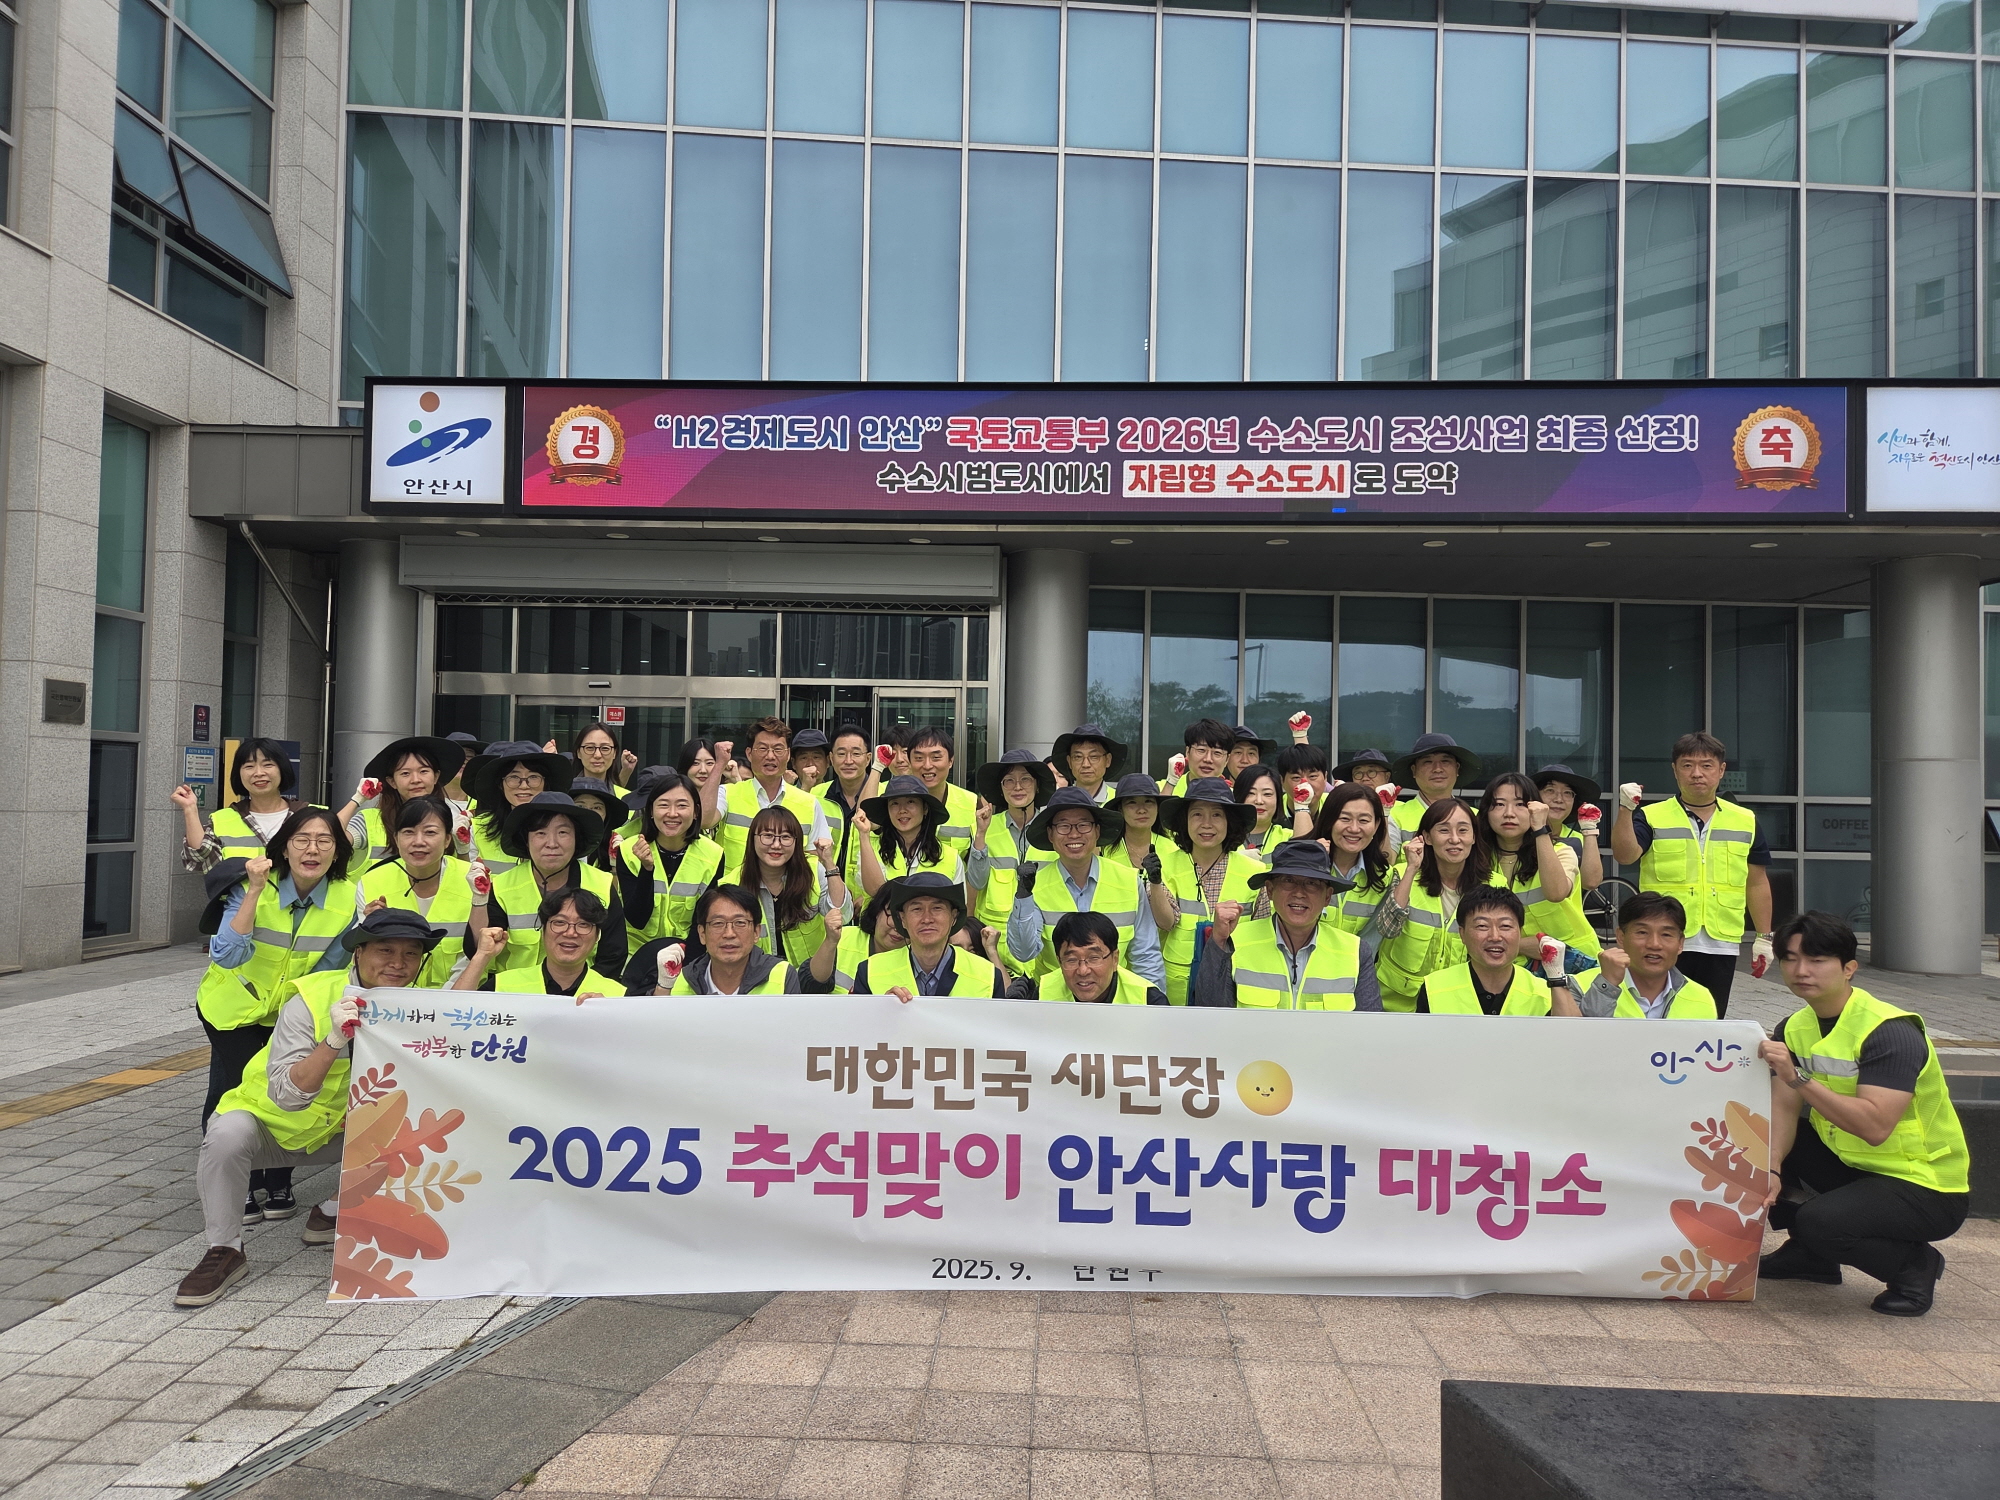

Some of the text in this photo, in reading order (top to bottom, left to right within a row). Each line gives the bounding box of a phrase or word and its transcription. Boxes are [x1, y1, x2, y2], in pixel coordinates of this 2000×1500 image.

[571, 425, 600, 459] 경
[722, 415, 849, 451] 경제도시
[947, 417, 1109, 452] 국토교통부
[1117, 416, 1239, 453] 2026년
[1248, 416, 1382, 453] 수소도시
[1391, 415, 1528, 452] 조성사업
[1536, 415, 1607, 452] 최종
[1615, 414, 1699, 452] 선정!
[1759, 425, 1794, 463] 축
[876, 460, 1111, 494] 수소시범도시에서
[1127, 463, 1216, 493] 자립형
[1392, 460, 1458, 495] 도약
[1888, 452, 1925, 472] 자유로운
[1928, 451, 1974, 471] 혁신도시
[403, 478, 473, 496] 안산시
[1822, 818, 1869, 831] COFFEE
[359, 1001, 517, 1031] 함께하며 혁신하는
[402, 1033, 528, 1064] 행복한 단원
[806, 1042, 1225, 1119] 대한민국 새단장
[508, 1124, 1607, 1242] 2025 추석맞이 안산사랑 대청소
[931, 1257, 1001, 1281] 2025.
[1009, 1261, 1032, 1281] 9.
